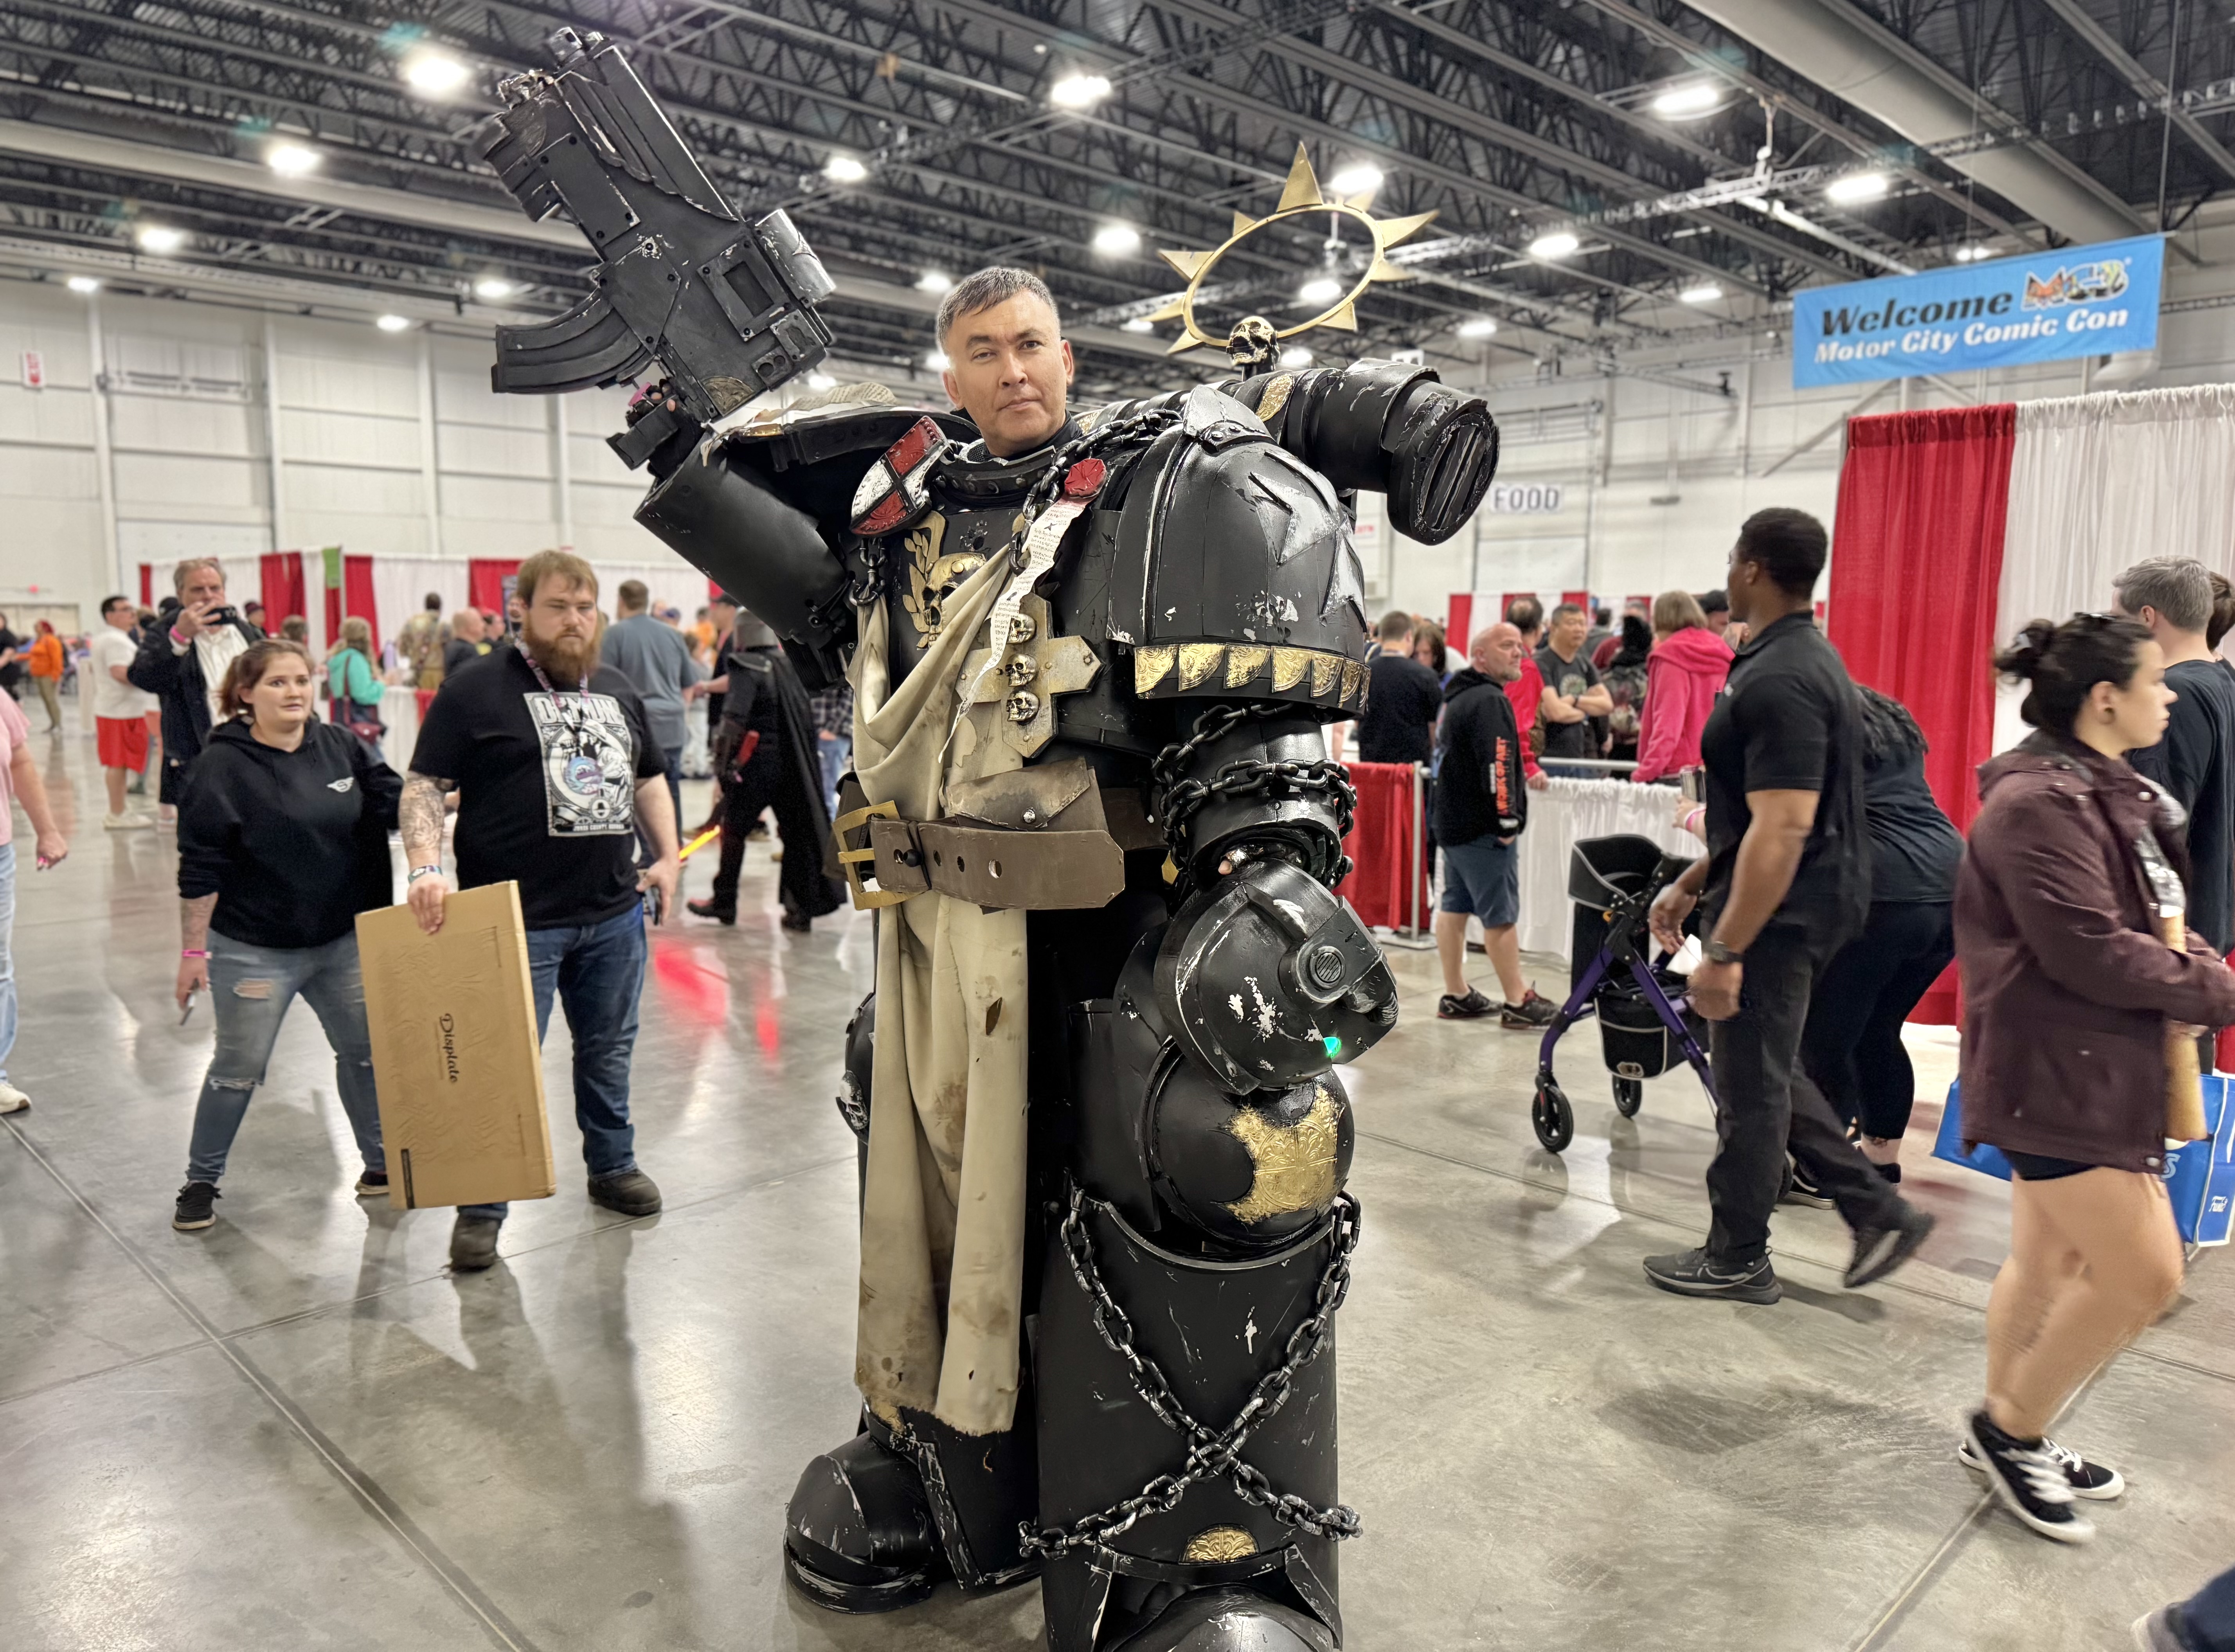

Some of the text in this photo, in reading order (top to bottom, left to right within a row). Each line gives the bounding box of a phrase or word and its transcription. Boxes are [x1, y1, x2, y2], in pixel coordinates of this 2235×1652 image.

[1815, 308, 2128, 364] Motor City Comic Con
[1821, 292, 2012, 337] Welcome
[1494, 487, 1559, 509] FOOD
[439, 1013, 459, 1083] Displate
